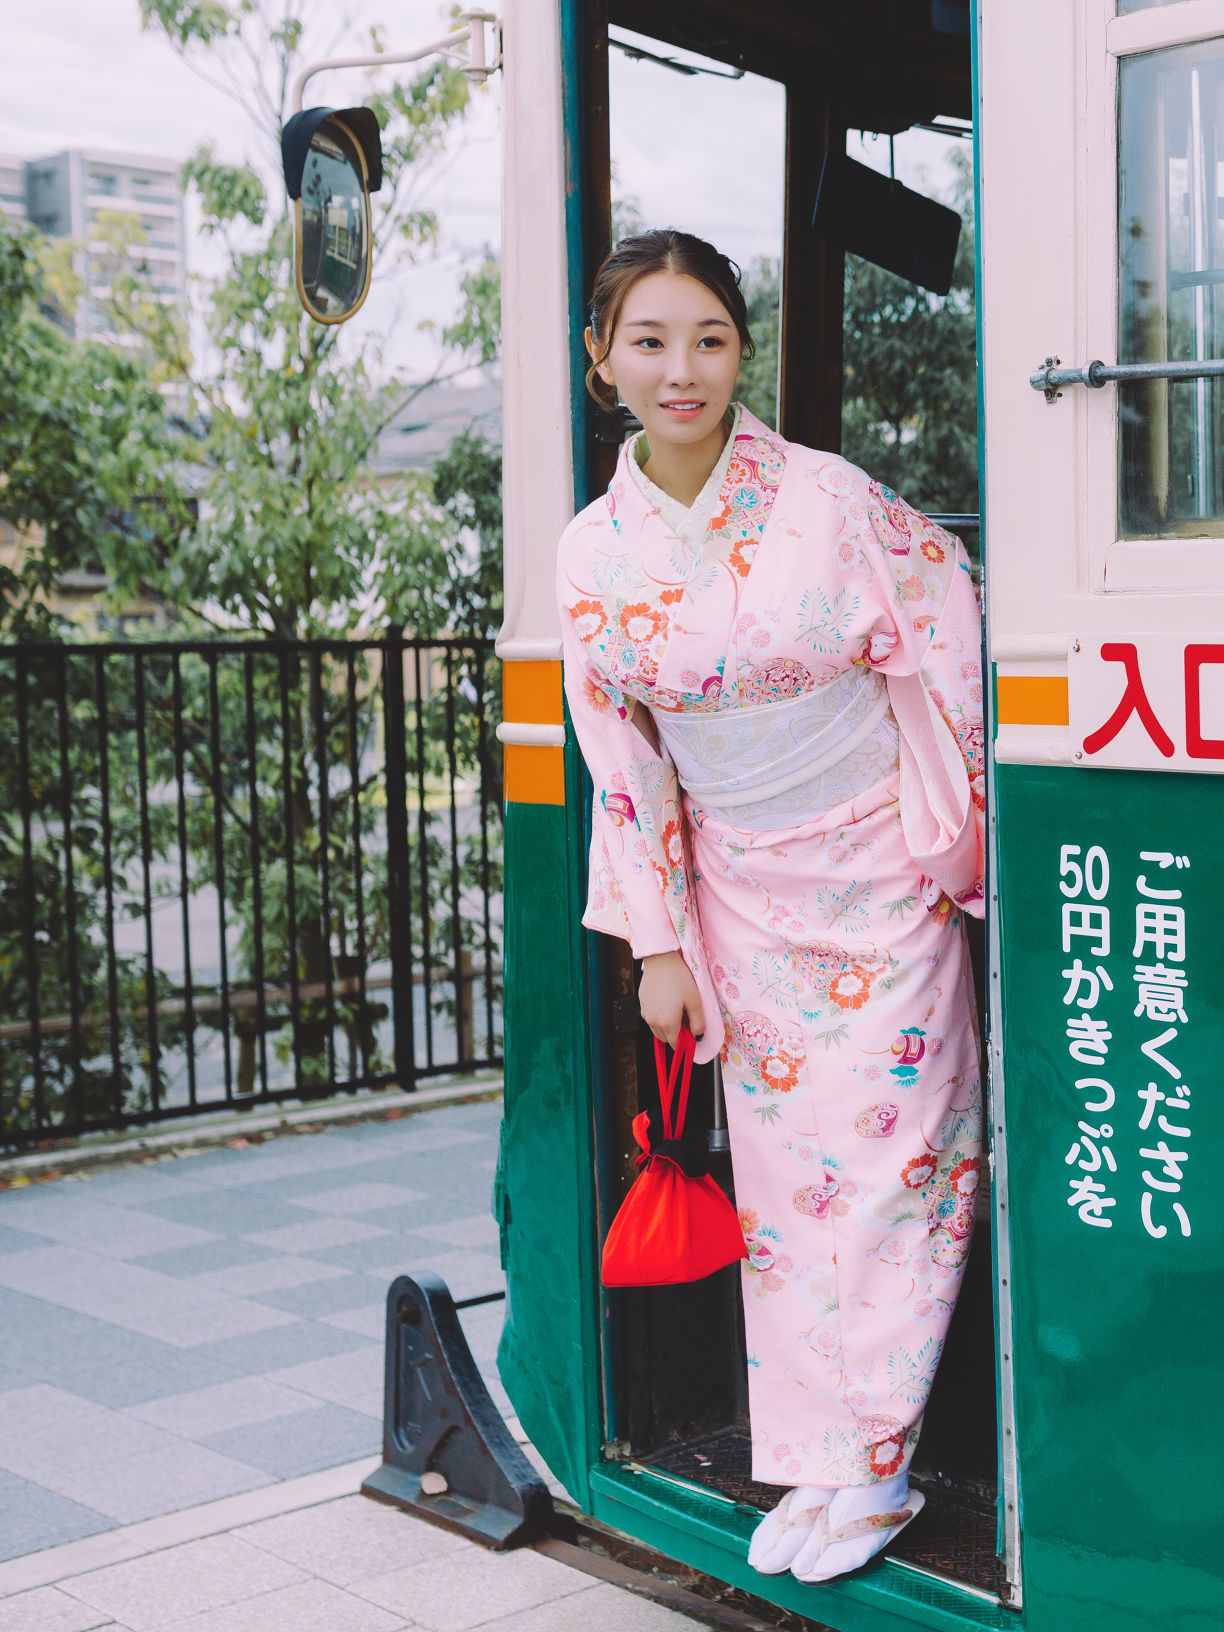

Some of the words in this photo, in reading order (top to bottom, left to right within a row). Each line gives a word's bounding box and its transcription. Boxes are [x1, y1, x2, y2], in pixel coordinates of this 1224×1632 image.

[1059, 844, 1118, 1229] 50円かきっぷを
[1133, 851, 1192, 1239] ご用意ください
